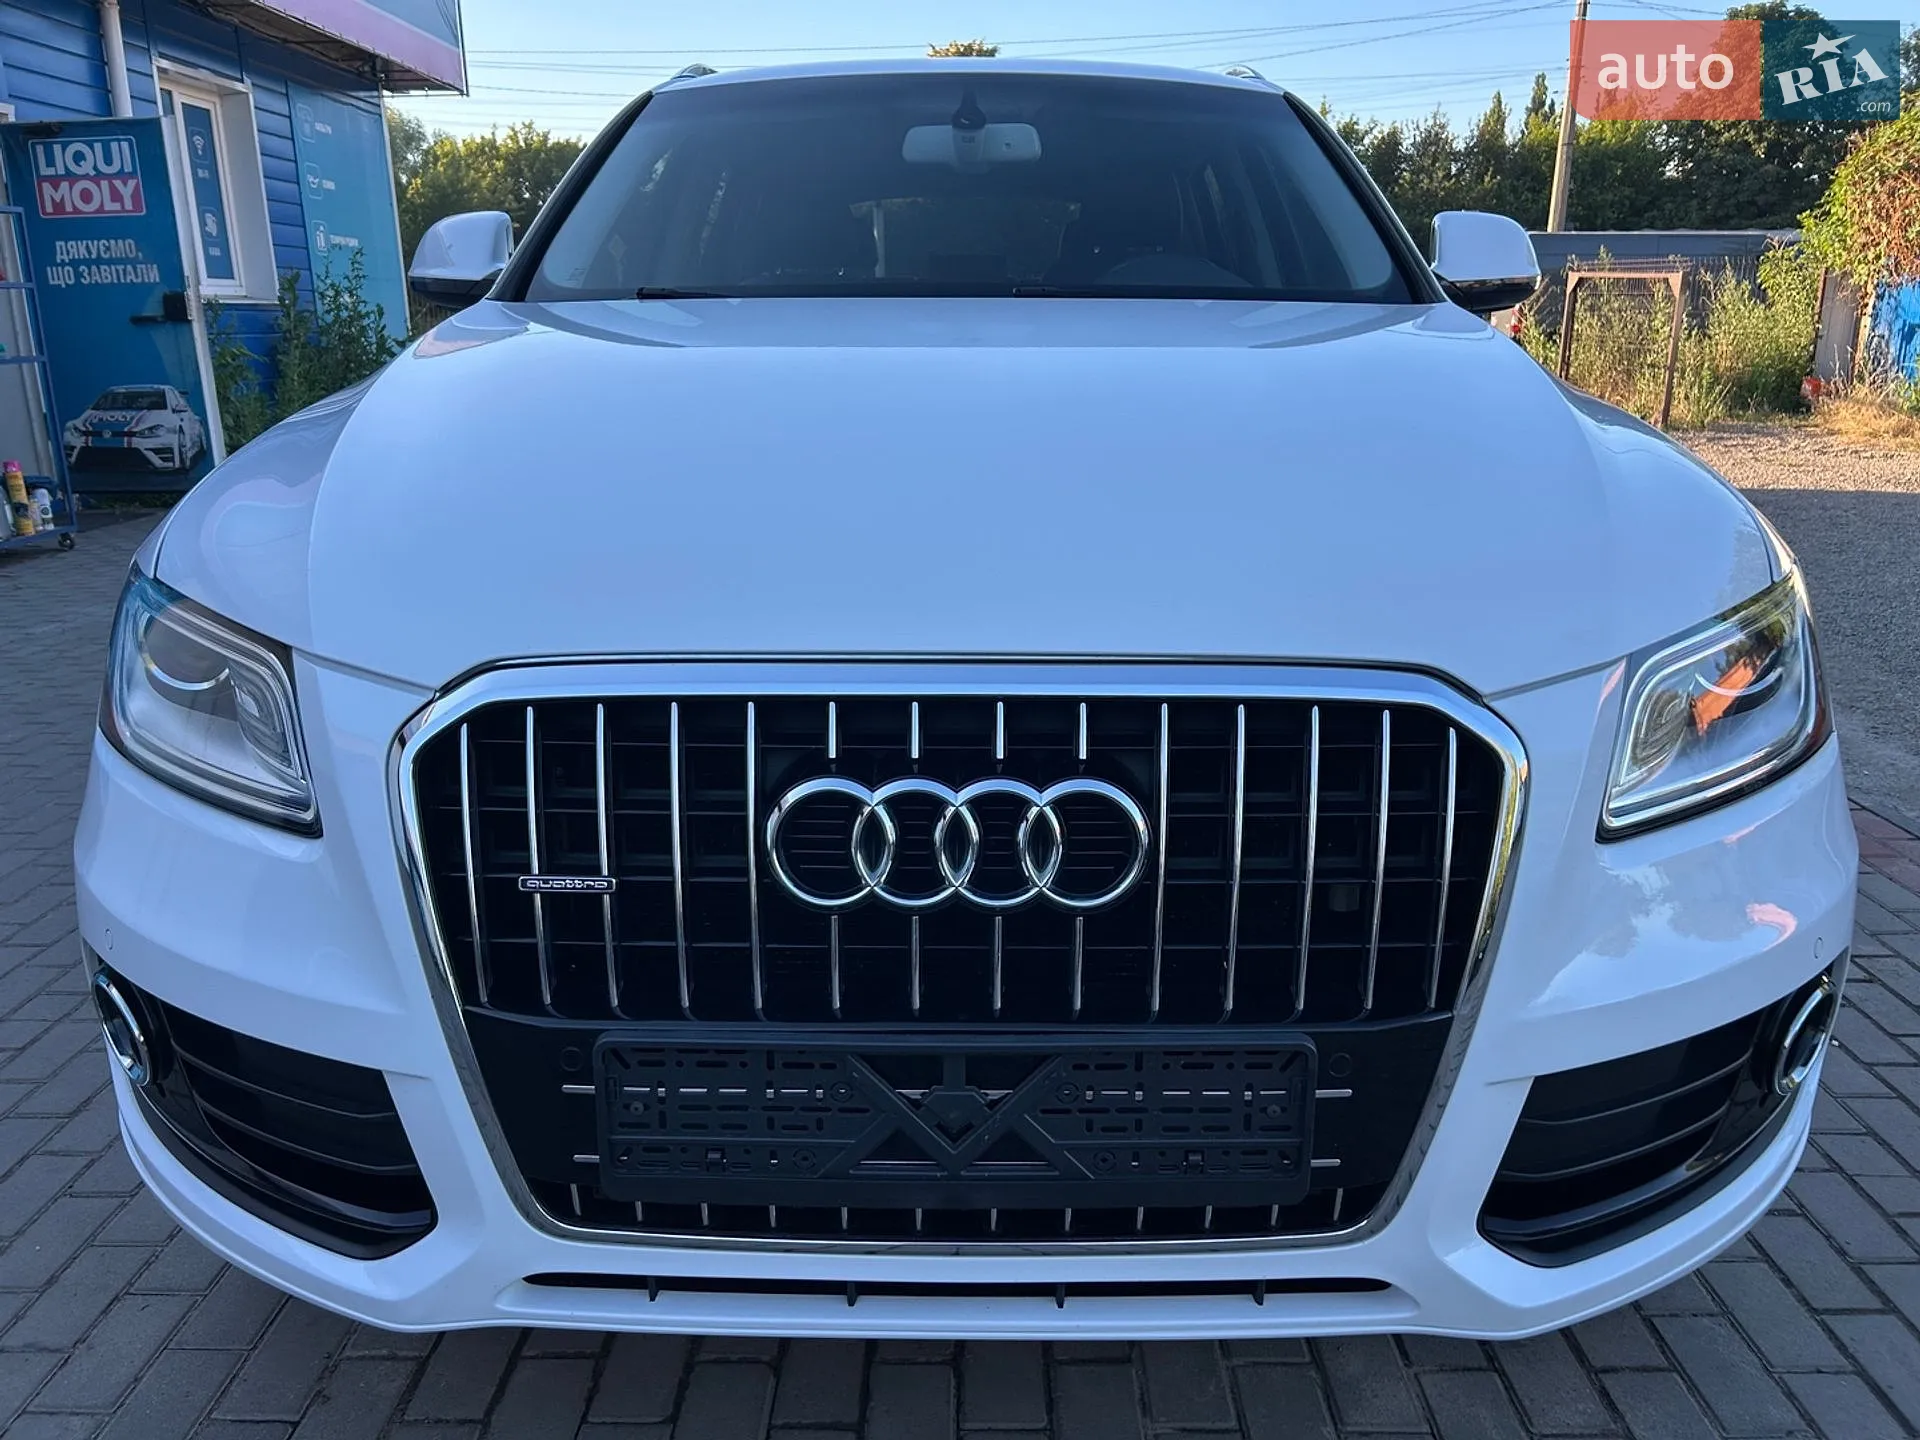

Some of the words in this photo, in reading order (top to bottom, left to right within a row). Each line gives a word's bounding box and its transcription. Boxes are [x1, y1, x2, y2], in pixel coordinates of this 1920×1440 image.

[35, 142, 133, 175] LIQUI
[42, 179, 138, 212] MOLY
[55, 239, 143, 263] ДЯКУЄМО,
[46, 265, 75, 288] ЩО
[80, 264, 160, 284] ЗАВІТАЛИ
[526, 880, 608, 889] quattro
